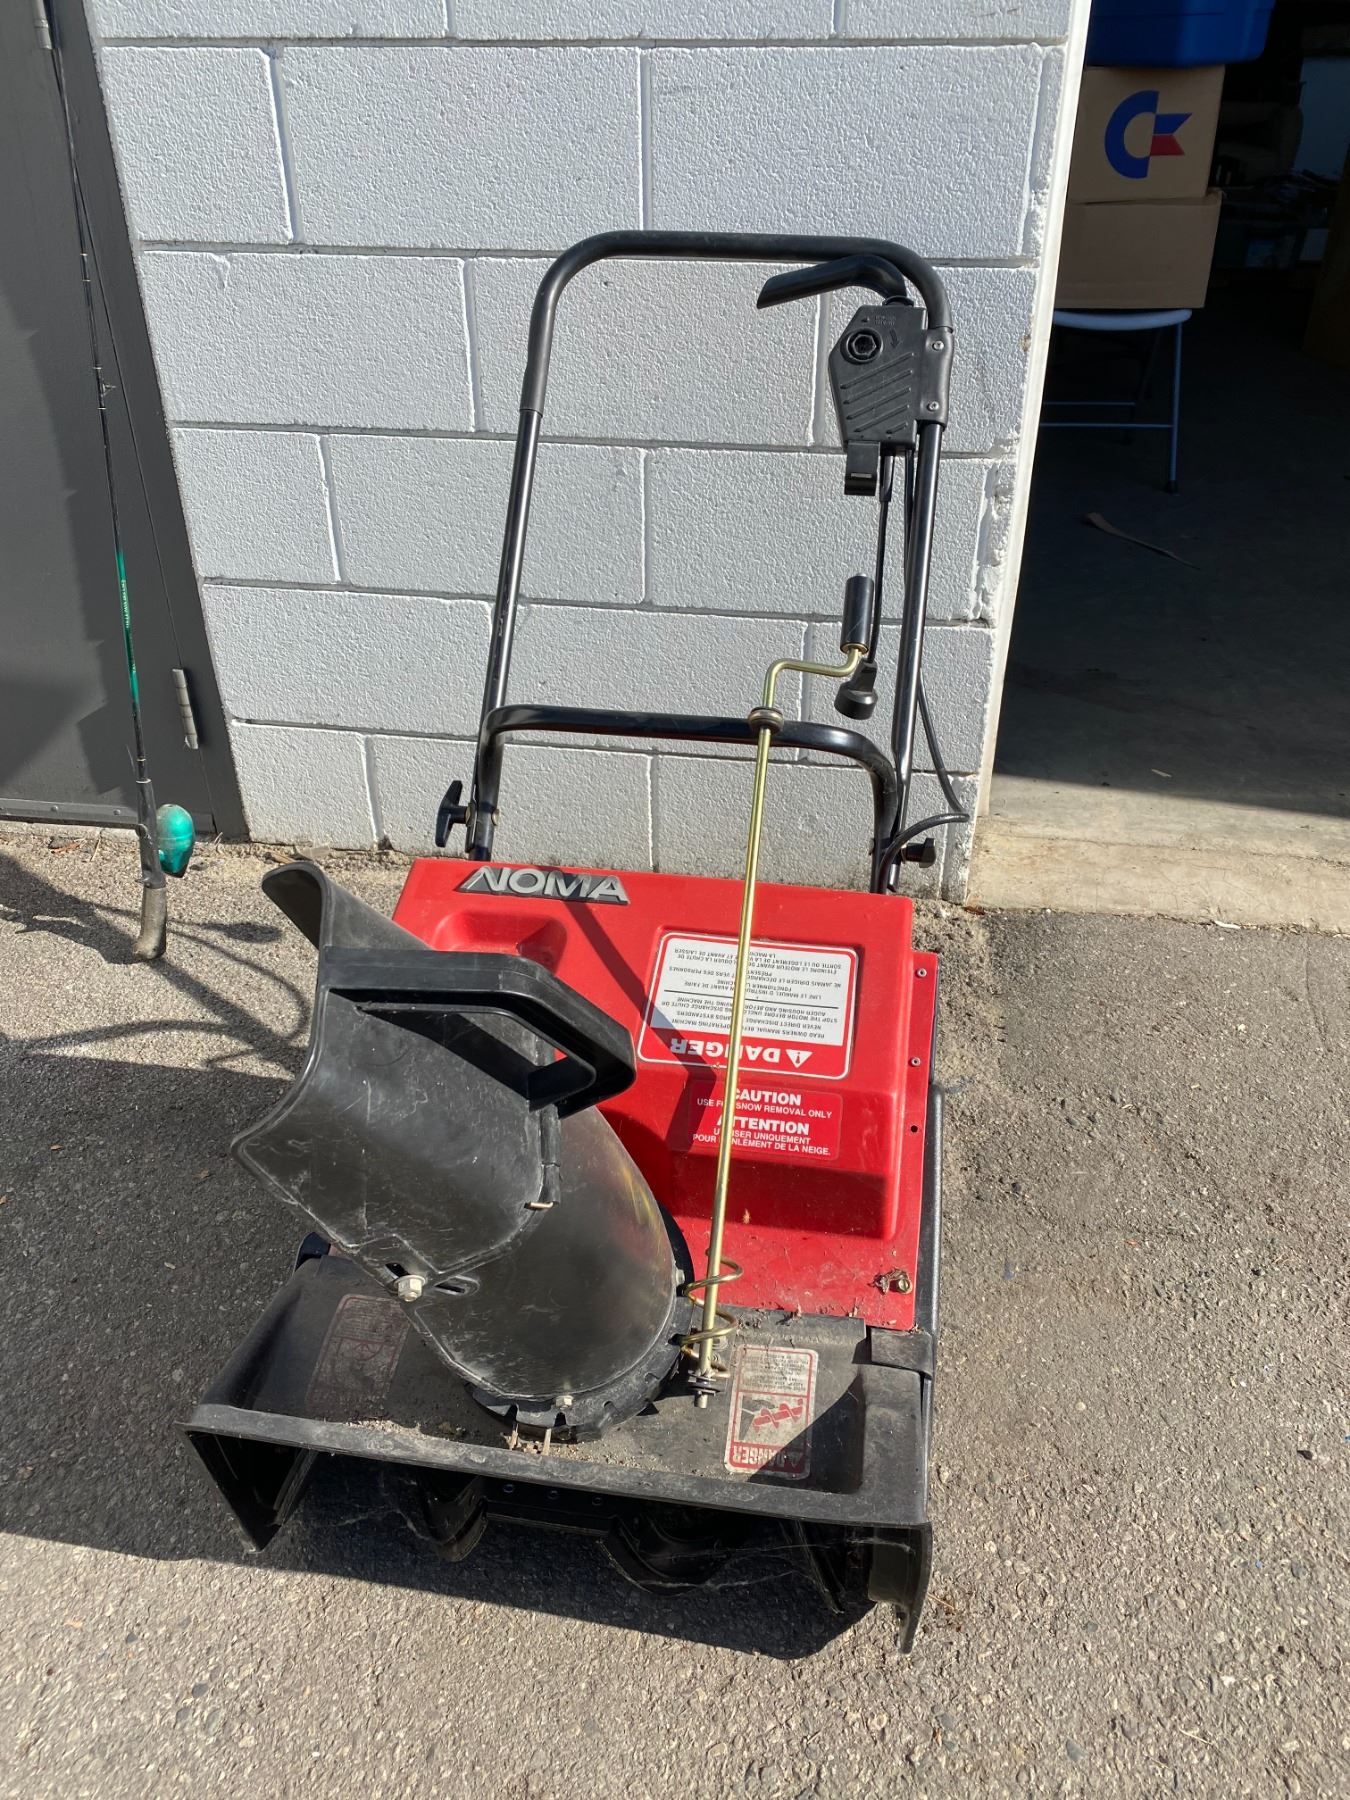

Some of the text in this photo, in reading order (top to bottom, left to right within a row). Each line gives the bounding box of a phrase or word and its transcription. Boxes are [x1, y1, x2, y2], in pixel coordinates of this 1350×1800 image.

[460, 865, 631, 904] NOMA
[669, 966, 701, 974] PERSONNES
[691, 1004, 723, 1012] DISCHARGE
[677, 1011, 714, 1019] BYSTANDERS
[698, 1021, 731, 1029] OPERATING
[746, 1018, 778, 1026] DISCHARGE
[697, 1098, 713, 1106] USE
[736, 1102, 762, 1111] SNOW
[764, 1105, 806, 1117] REMOVAL
[808, 1109, 832, 1119] ONLY
[714, 1128, 811, 1144] UISER UNIQUEMENT
[693, 1134, 716, 1143] POUR
[774, 1142, 786, 1150] DE
[788, 1143, 800, 1153] LA
[802, 1145, 830, 1155] NEIGE.
